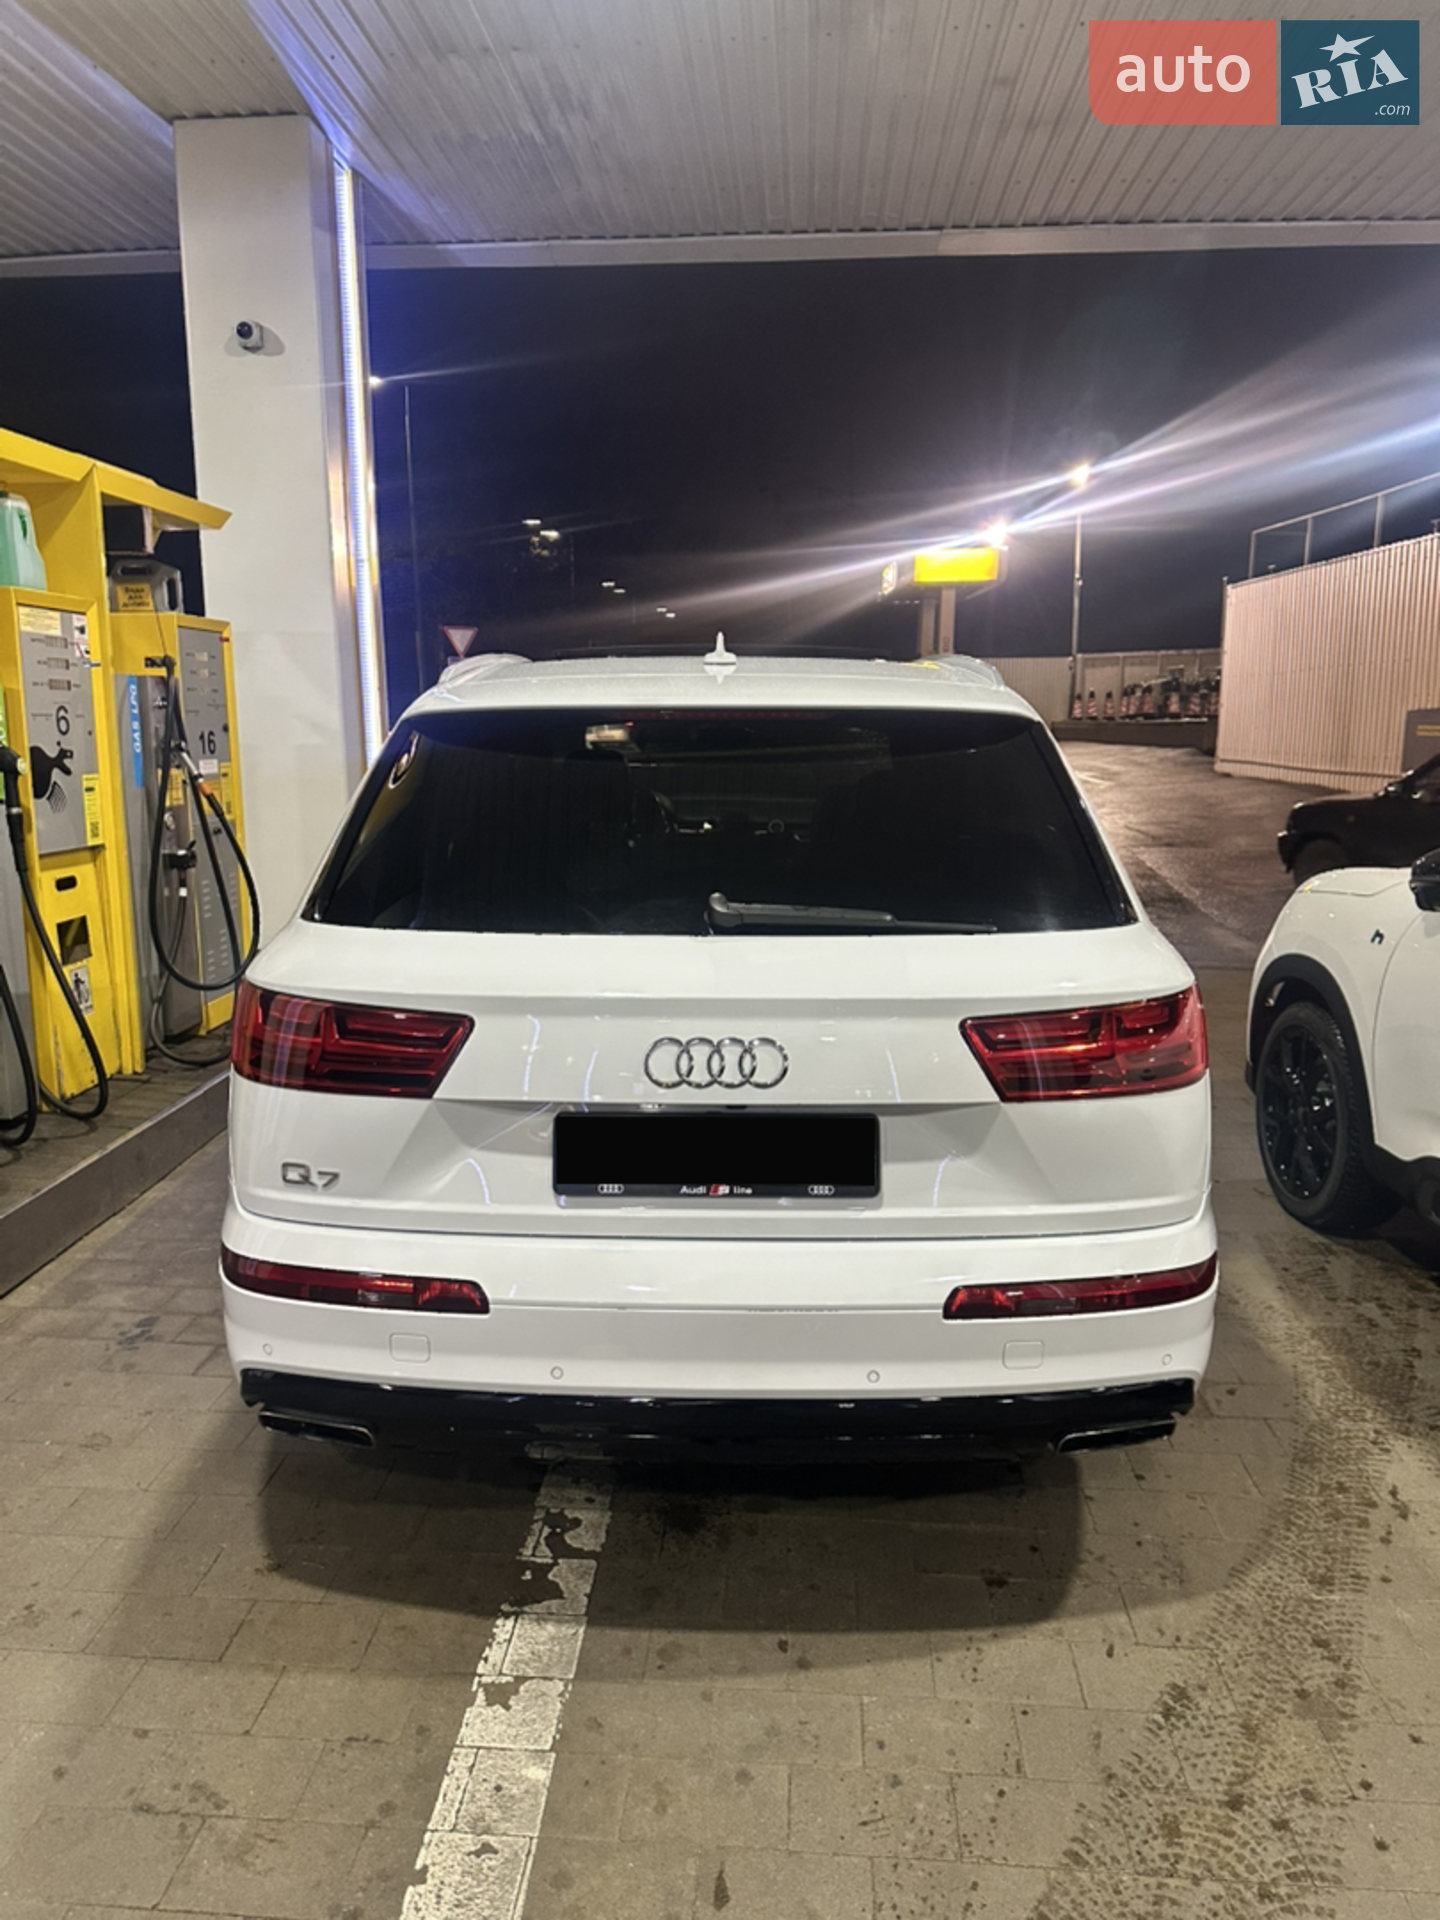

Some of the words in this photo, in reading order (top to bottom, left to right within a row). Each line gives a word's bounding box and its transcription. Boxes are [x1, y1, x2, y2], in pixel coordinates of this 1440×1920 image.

[129, 684, 138, 714] LPG
[56, 705, 70, 736] 6
[131, 721, 141, 753] GAS
[199, 730, 216, 755] 16
[281, 1162, 340, 1188] Q7
[680, 1185, 707, 1194] Audi
[733, 1185, 753, 1194] line
